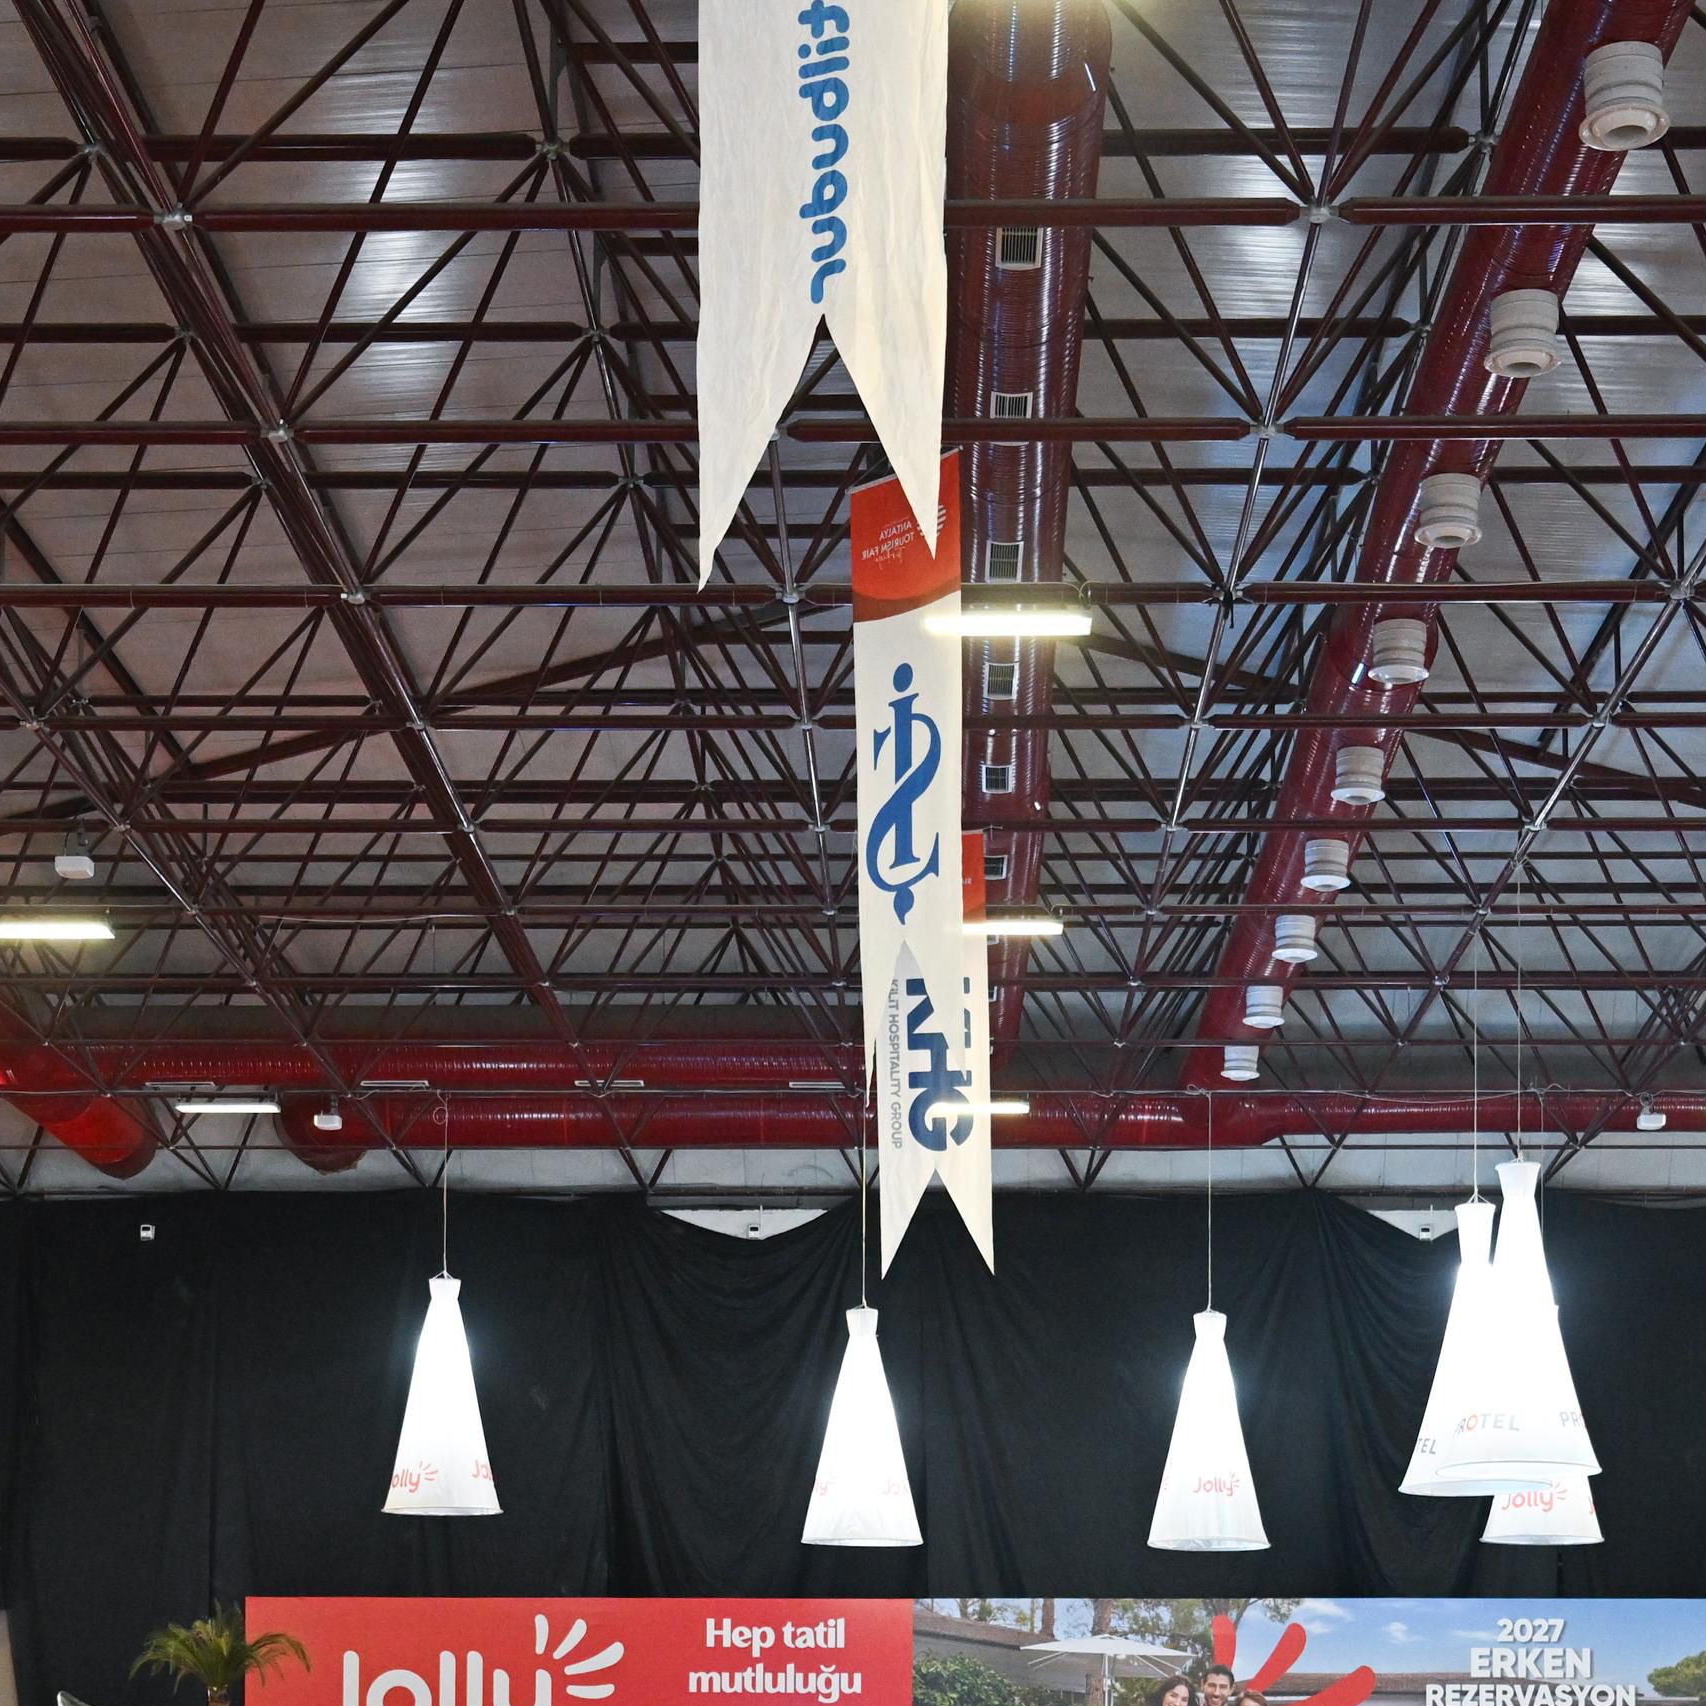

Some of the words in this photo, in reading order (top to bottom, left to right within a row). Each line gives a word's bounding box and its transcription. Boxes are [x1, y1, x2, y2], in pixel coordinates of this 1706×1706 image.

[888, 1014, 902, 1099] HOSPITALITY
[890, 1102, 903, 1149] GROUP
[391, 1469, 421, 1493] olly
[1193, 1476, 1234, 1497] Jolly
[1501, 1489, 1555, 1513] Jolly
[705, 1616, 775, 1658] Hep
[783, 1616, 846, 1651] tatil
[1496, 1618, 1565, 1643] 2027
[1470, 1647, 1592, 1679] ERKEN
[688, 1661, 863, 1704] mutluluğu
